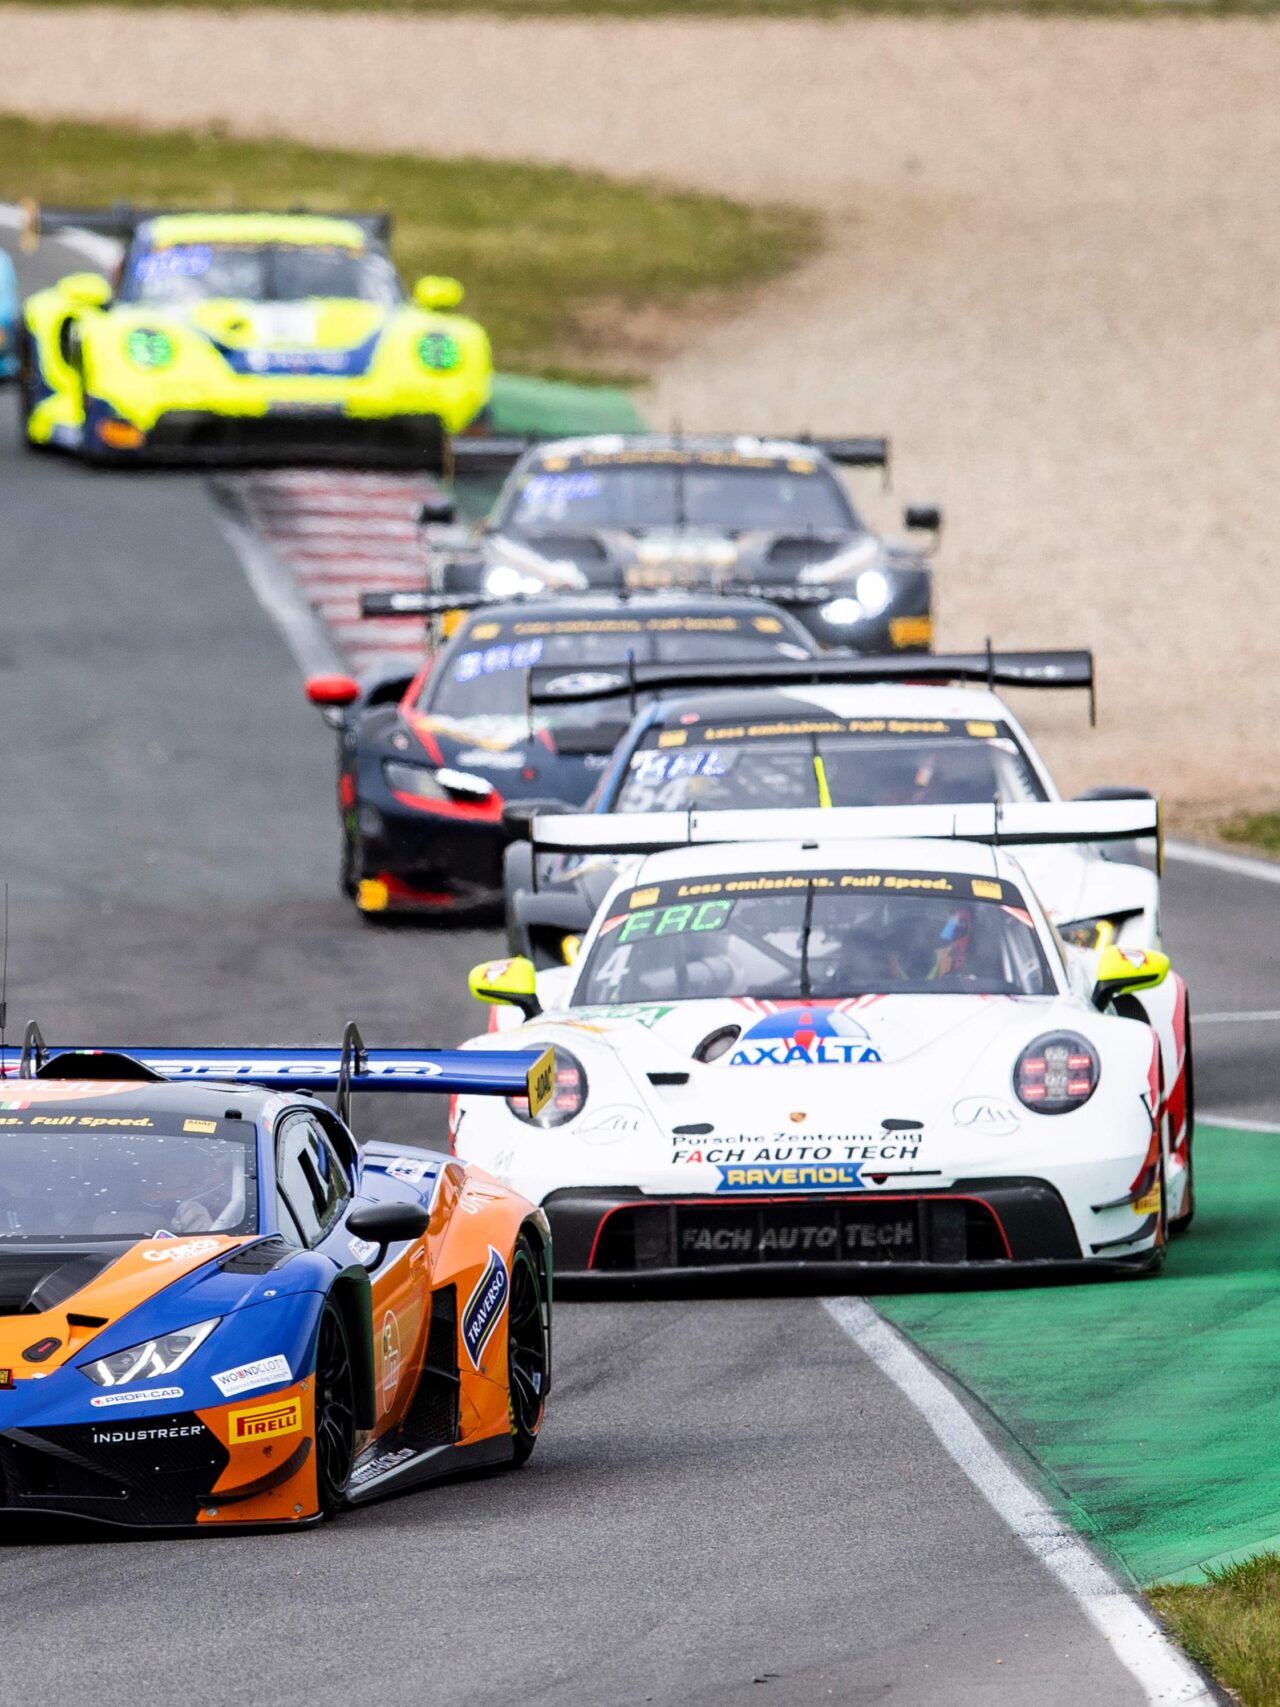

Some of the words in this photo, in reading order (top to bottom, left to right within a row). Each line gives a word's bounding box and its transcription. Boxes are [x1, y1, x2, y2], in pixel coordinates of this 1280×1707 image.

[677, 882, 722, 897] Less
[840, 875, 881, 887] Full
[883, 876, 953, 890] Speed.
[617, 899, 732, 944] FAC
[596, 944, 633, 987] 4
[729, 1044, 883, 1066] AXALTA
[30, 1115, 77, 1126] Full
[78, 1116, 155, 1127] Speed.
[672, 1134, 764, 1147] Porsche
[773, 1132, 873, 1143] Zentrum
[880, 1129, 923, 1143] Zug
[672, 1149, 746, 1164] FACH
[754, 1146, 833, 1161] AUTO
[845, 1145, 920, 1160] TECH
[727, 1167, 853, 1185] RAVENOL
[682, 1227, 753, 1251] FACH
[758, 1225, 838, 1250] AUTO
[845, 1222, 914, 1248] TECH
[467, 1270, 504, 1344] TRAVERSO
[218, 1359, 282, 1385] WOUNDCLOT
[106, 1388, 181, 1403] PROFI-CAR
[236, 1405, 297, 1437] PIRELLI
[93, 1426, 201, 1443] INDUSTREER
